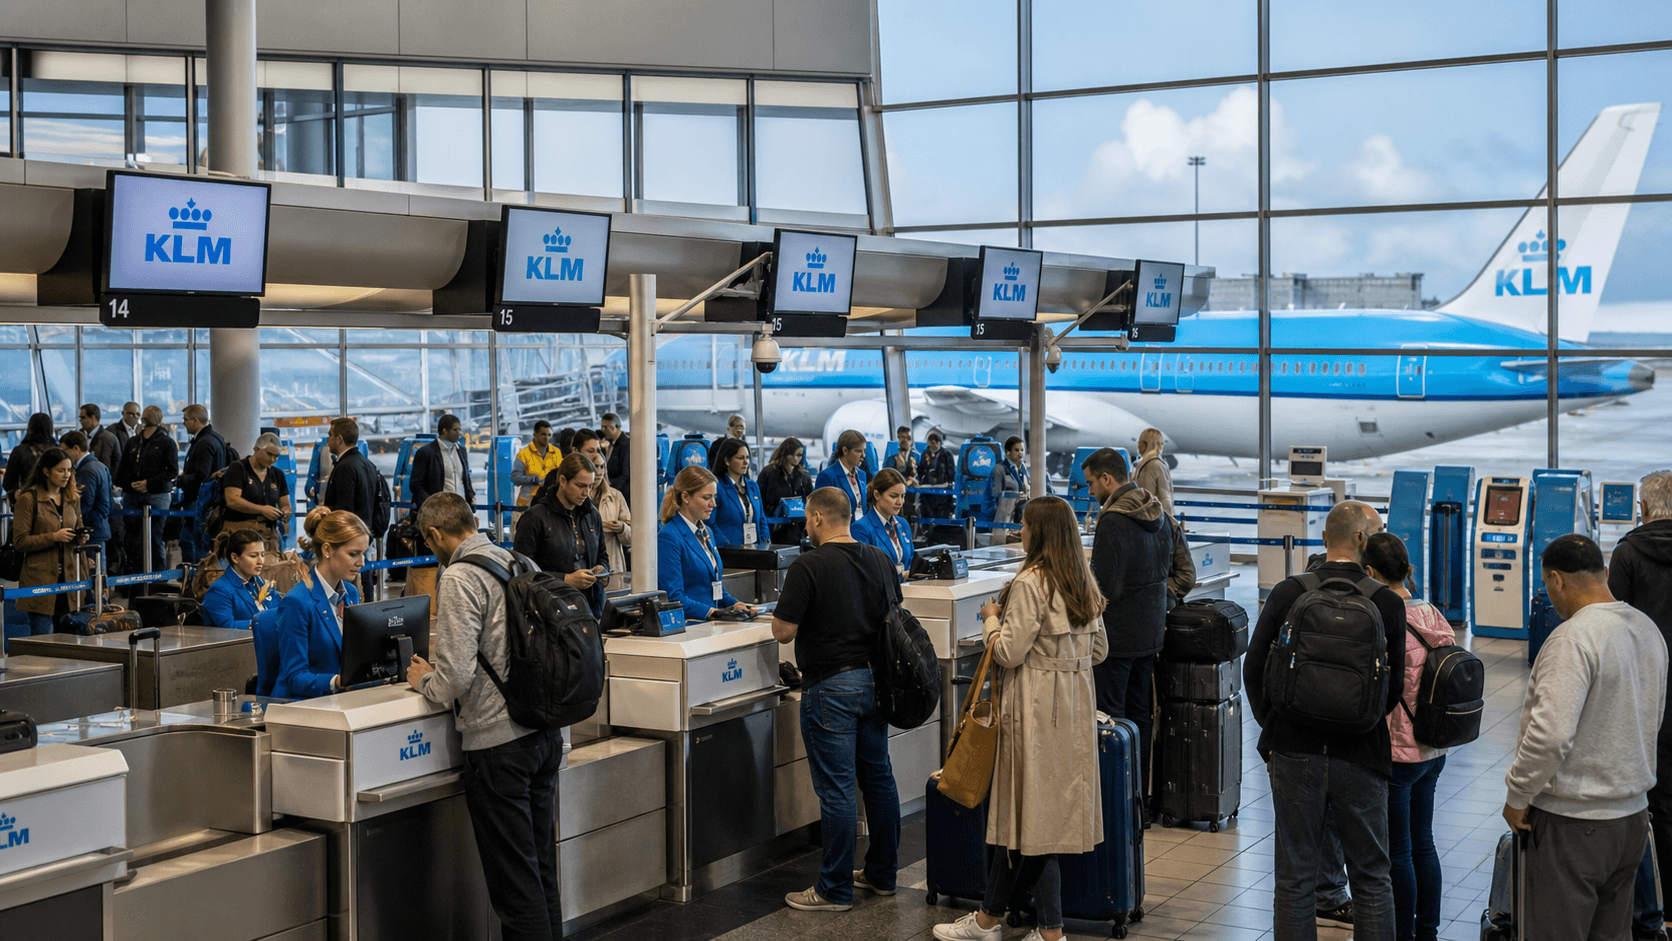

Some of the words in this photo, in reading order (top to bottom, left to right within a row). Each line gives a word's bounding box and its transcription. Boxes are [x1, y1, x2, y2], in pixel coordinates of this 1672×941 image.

[145, 233, 232, 265] KLM
[526, 255, 584, 281] KLM
[792, 271, 836, 293] KLM
[1495, 266, 1592, 297] KLM
[993, 283, 1026, 301] KLM
[1145, 292, 1171, 308] KLM
[109, 298, 130, 318] 14
[500, 309, 513, 325] 15
[772, 317, 782, 331] 15
[779, 350, 847, 372] KLM
[722, 668, 742, 683] KLM
[400, 741, 431, 761] KLM
